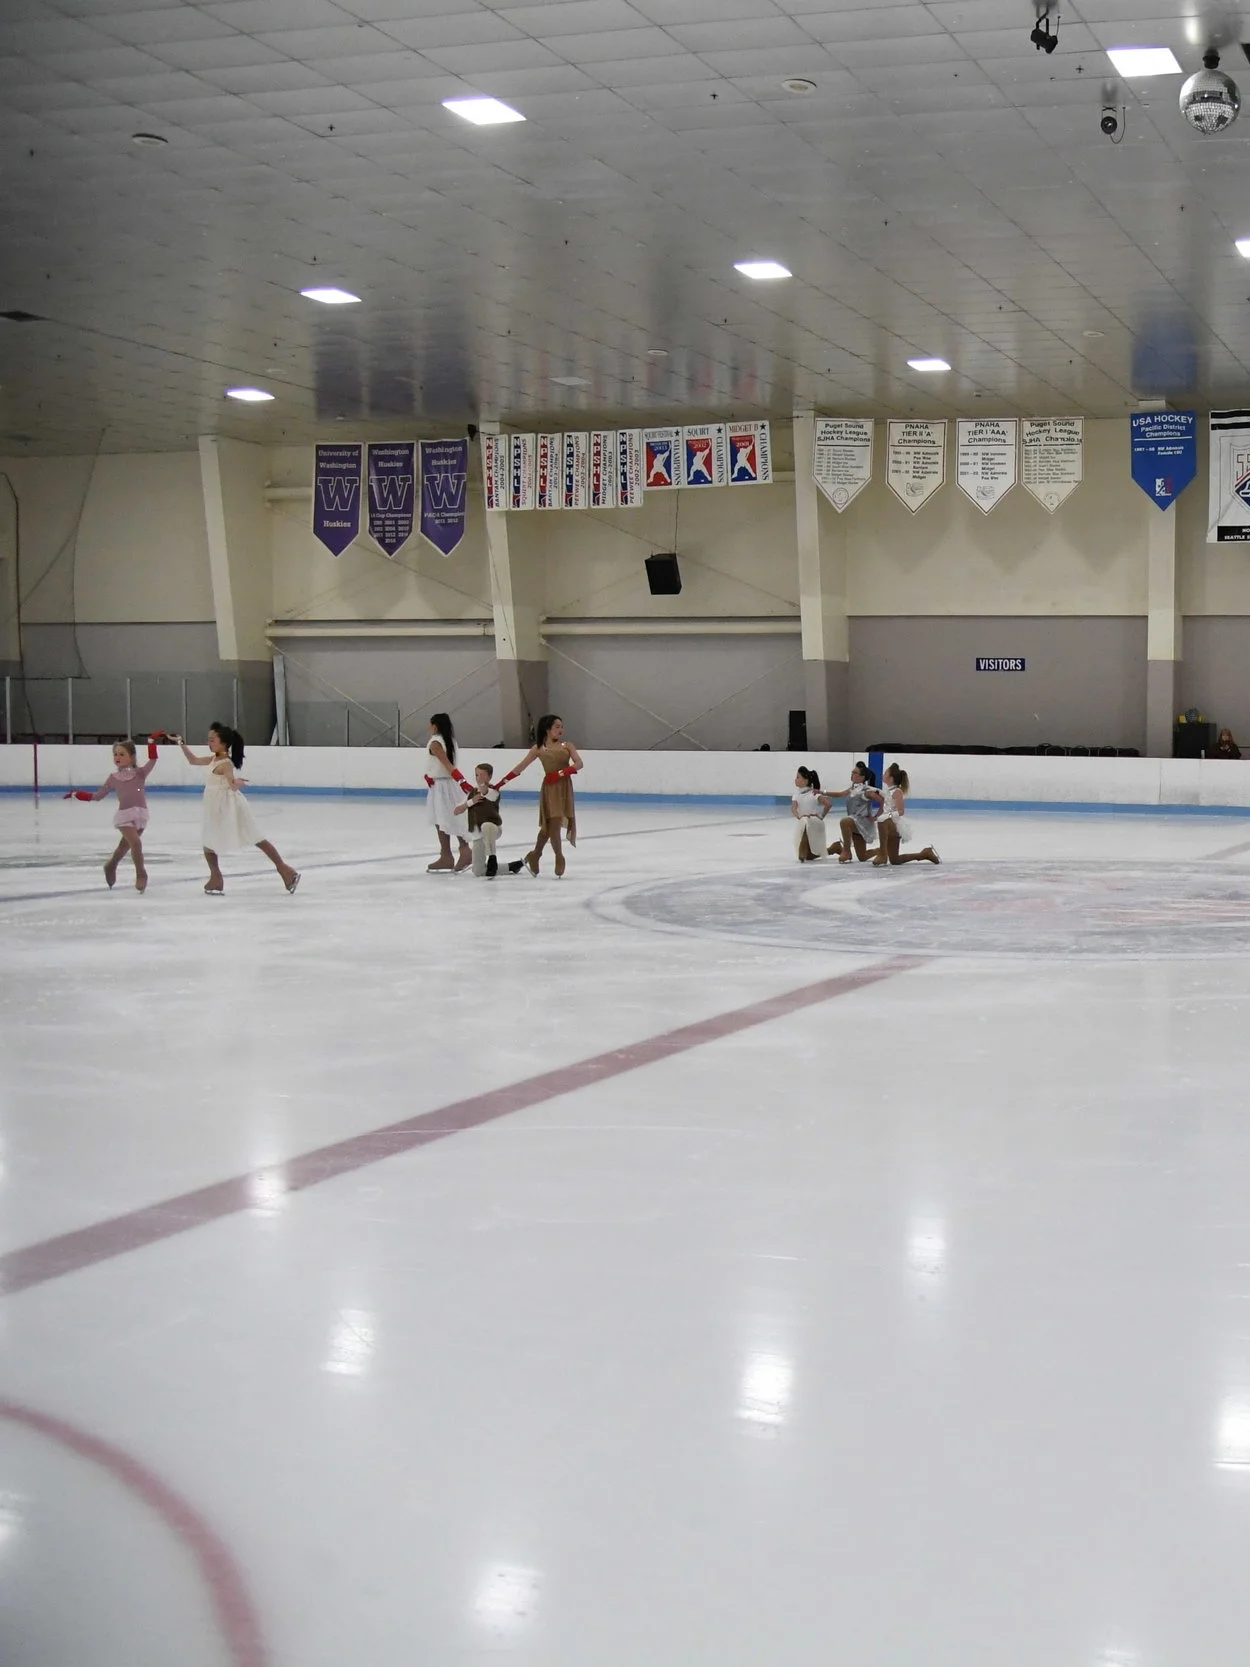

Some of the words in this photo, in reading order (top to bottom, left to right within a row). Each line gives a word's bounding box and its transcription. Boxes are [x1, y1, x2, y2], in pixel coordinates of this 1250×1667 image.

[1133, 416, 1152, 426] USA
[1154, 415, 1193, 424] HOCKEY
[688, 428, 709, 436] SQUIRT
[1026, 429, 1050, 437] Hockey
[1055, 428, 1079, 436] League
[760, 432, 769, 480] CHAMPIONS
[317, 477, 359, 511] W
[369, 475, 412, 510] W
[424, 473, 467, 509] W
[980, 659, 1022, 669] VISITORS
